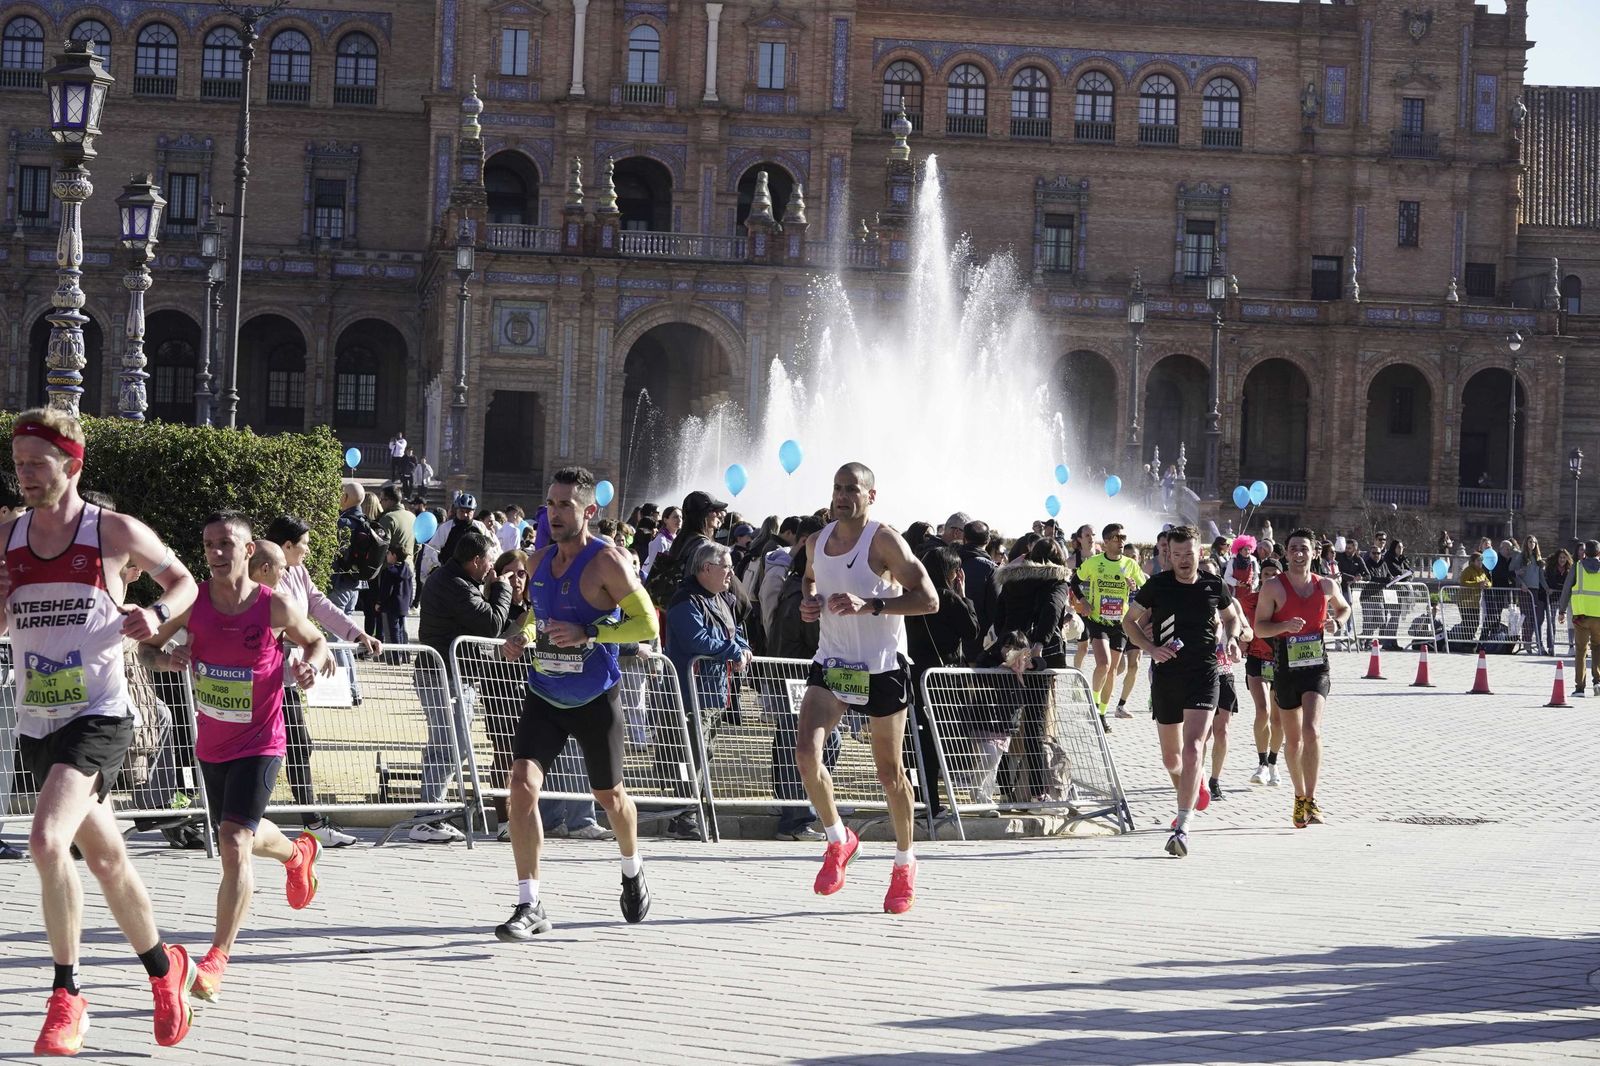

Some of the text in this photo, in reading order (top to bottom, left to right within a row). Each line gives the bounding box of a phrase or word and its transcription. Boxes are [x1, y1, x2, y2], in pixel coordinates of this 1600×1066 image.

[13, 598, 96, 614] GATESHEAD
[558, 653, 582, 661] MONTES
[1297, 650, 1315, 660] JACK
[210, 668, 245, 678] ZURICH
[212, 684, 229, 694] 3088
[844, 684, 869, 694] SMILE
[25, 687, 82, 704] DOUGLAS
[196, 688, 250, 709] TOMASIYO
